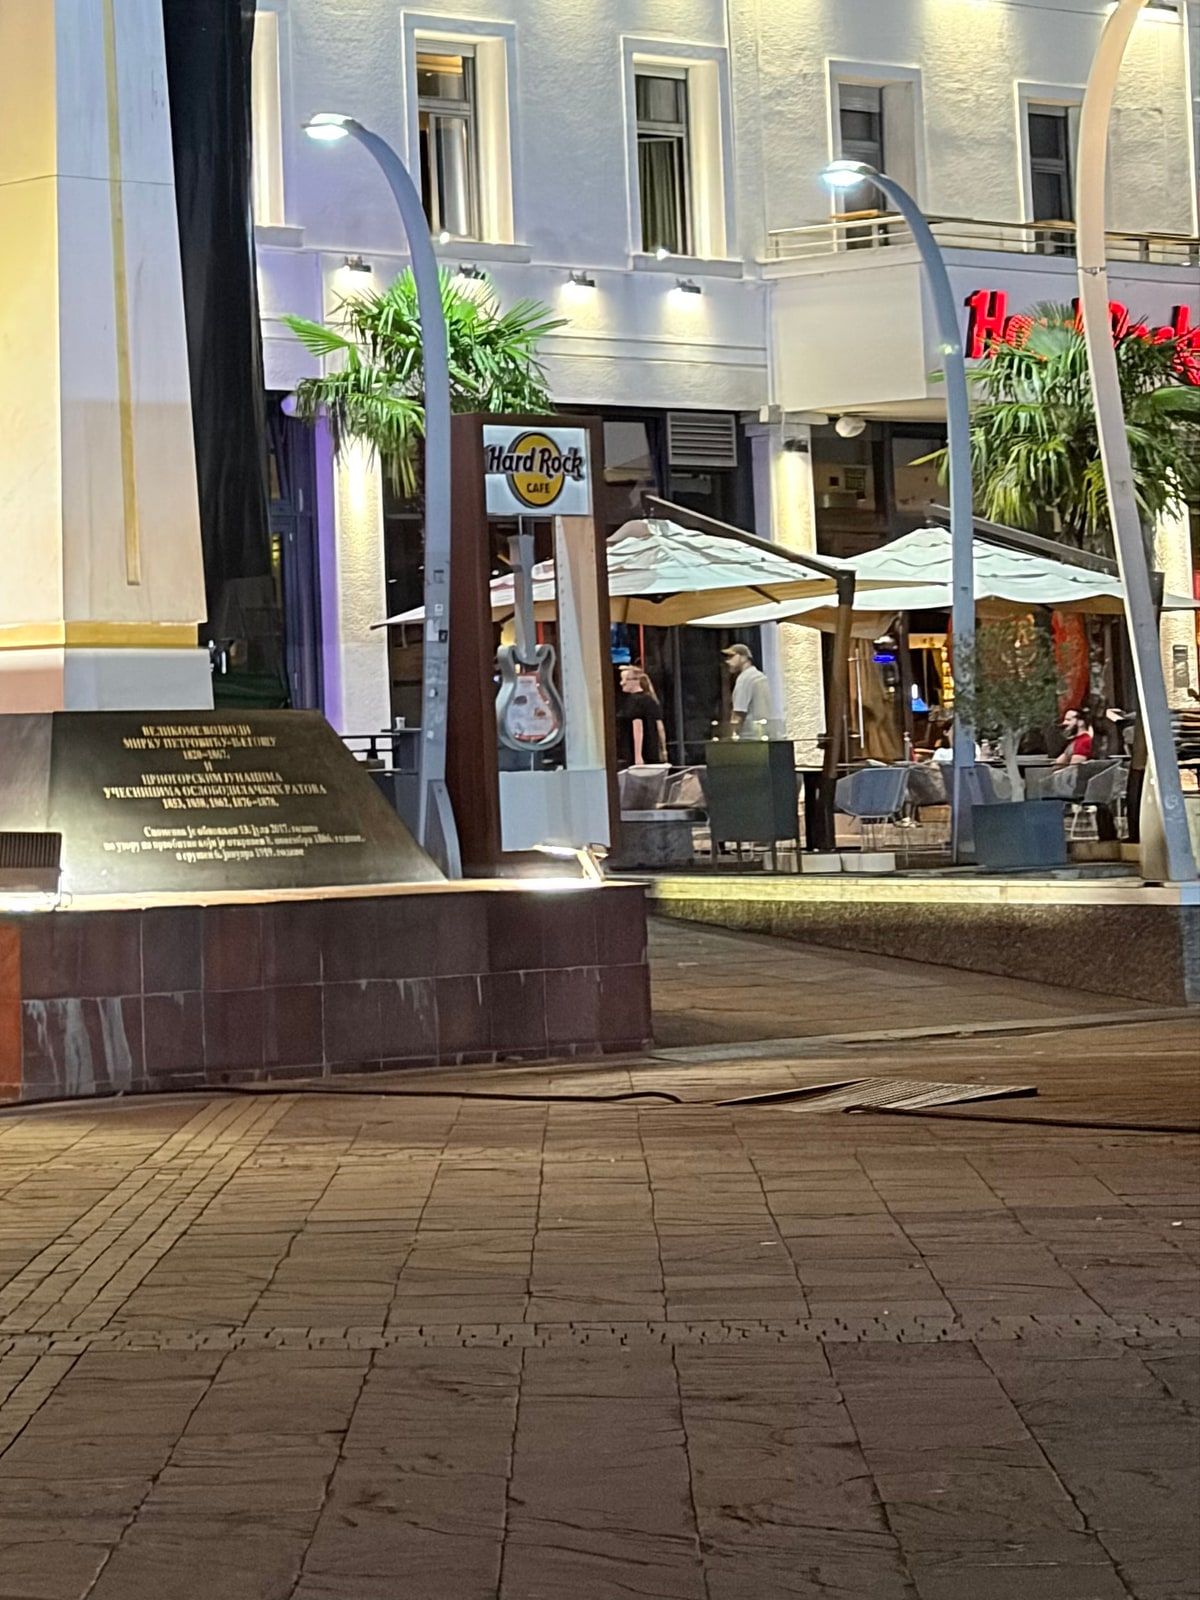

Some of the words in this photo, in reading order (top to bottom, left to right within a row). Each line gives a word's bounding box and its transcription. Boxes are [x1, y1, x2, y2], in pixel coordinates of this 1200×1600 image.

[486, 445, 535, 473] Hard
[538, 446, 585, 481] Rock
[526, 482, 550, 494] CAFE
[123, 737, 161, 749] МИРКУ
[141, 772, 223, 786] ЦРНОГОРСКИМ
[102, 786, 182, 799] УЧЕСНИЦИМА
[182, 784, 284, 797] ОСЛОБОДИЛАЧКИХ
[284, 783, 328, 795] РАТОВА
